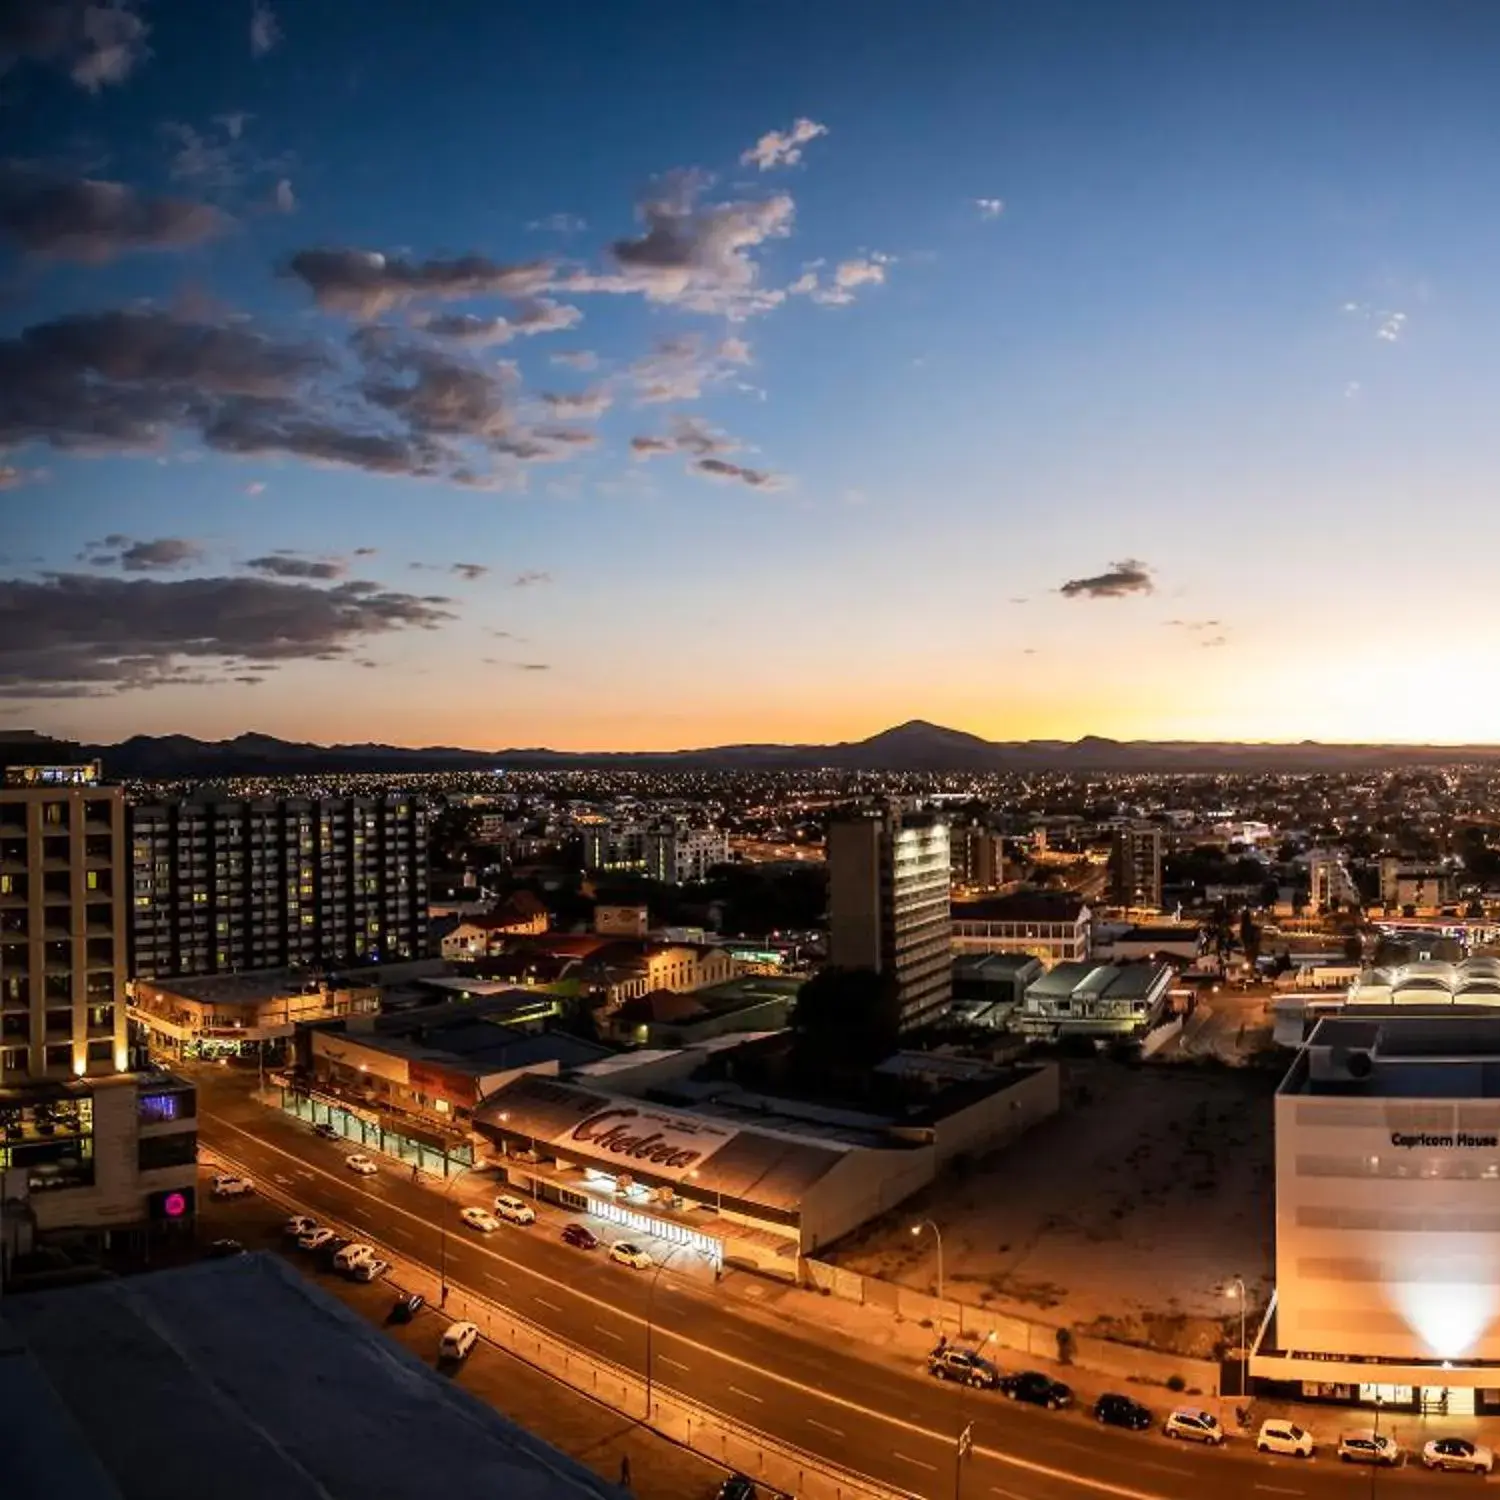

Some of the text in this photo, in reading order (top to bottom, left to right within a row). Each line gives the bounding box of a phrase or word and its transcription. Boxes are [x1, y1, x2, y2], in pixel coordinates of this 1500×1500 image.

[571, 1108, 702, 1169] Chelsea
[1391, 1132, 1499, 1149] Capricorn House
